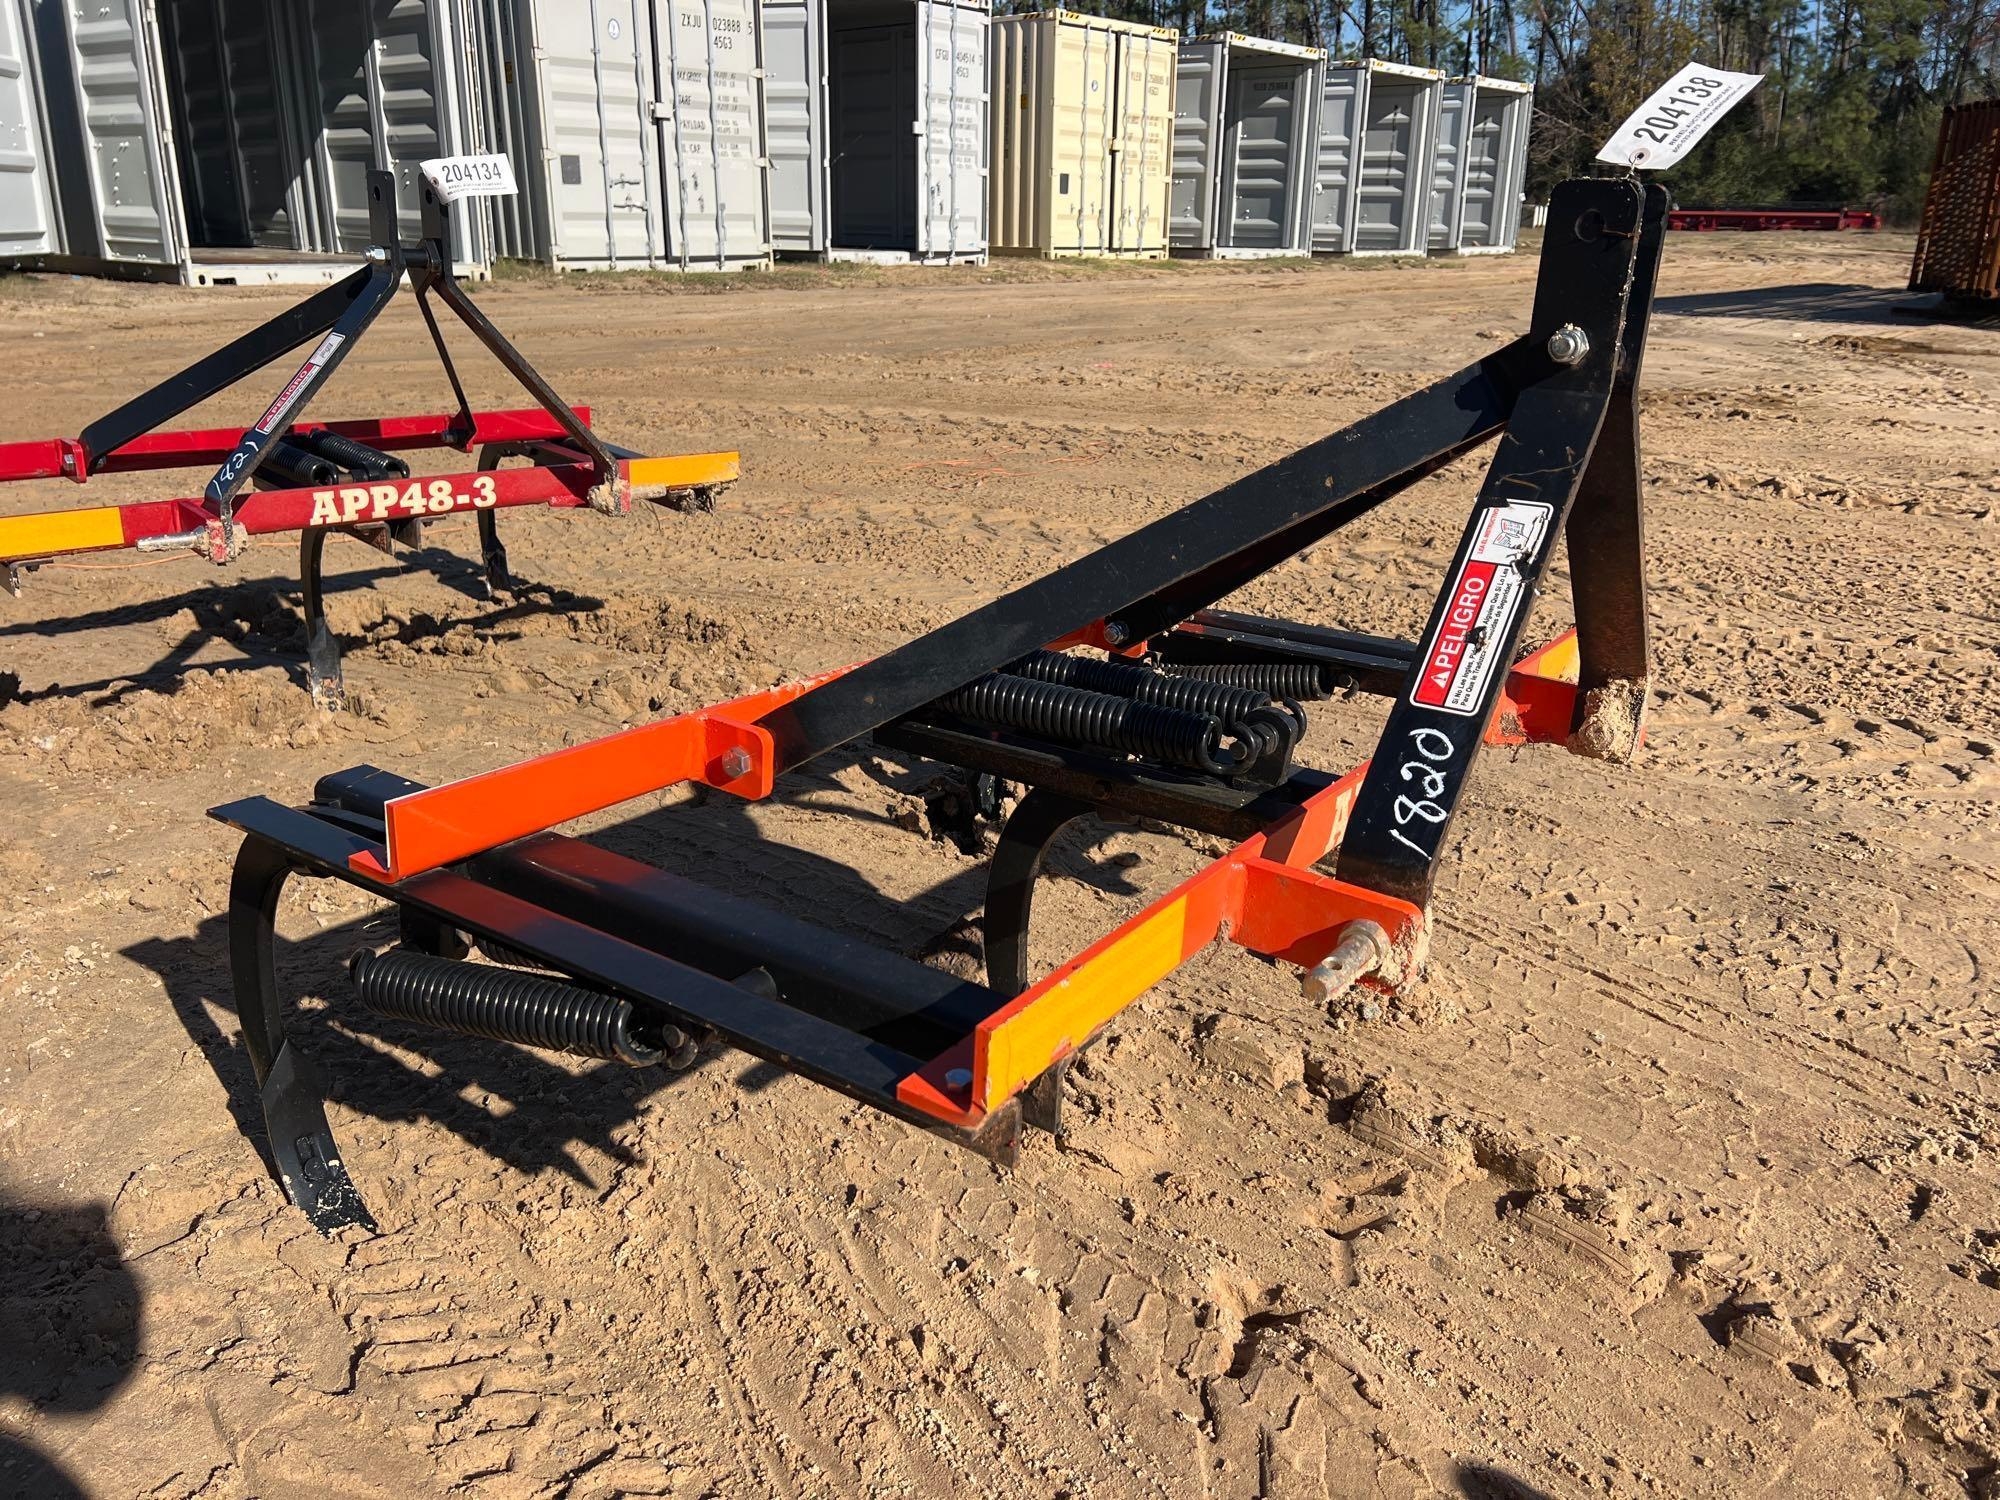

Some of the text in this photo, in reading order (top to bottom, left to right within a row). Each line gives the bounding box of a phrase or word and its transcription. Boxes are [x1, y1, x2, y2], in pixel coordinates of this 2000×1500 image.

[680, 13, 753, 35] ZXJU 023888 5
[713, 36, 733, 50] 45G3
[1633, 76, 1723, 144] 204138
[441, 162, 502, 184] 204134
[272, 370, 308, 415] PELIGRO
[310, 475, 497, 526] APP48-3
[1482, 604, 1496, 625] Alguien
[1490, 592, 1500, 604] Que
[1435, 577, 1485, 669] PELIGRO
[1454, 689, 1463, 698] No
[1460, 693, 1471, 706] Para
[1465, 682, 1475, 693] Que
[1388, 728, 1455, 860] 1820
